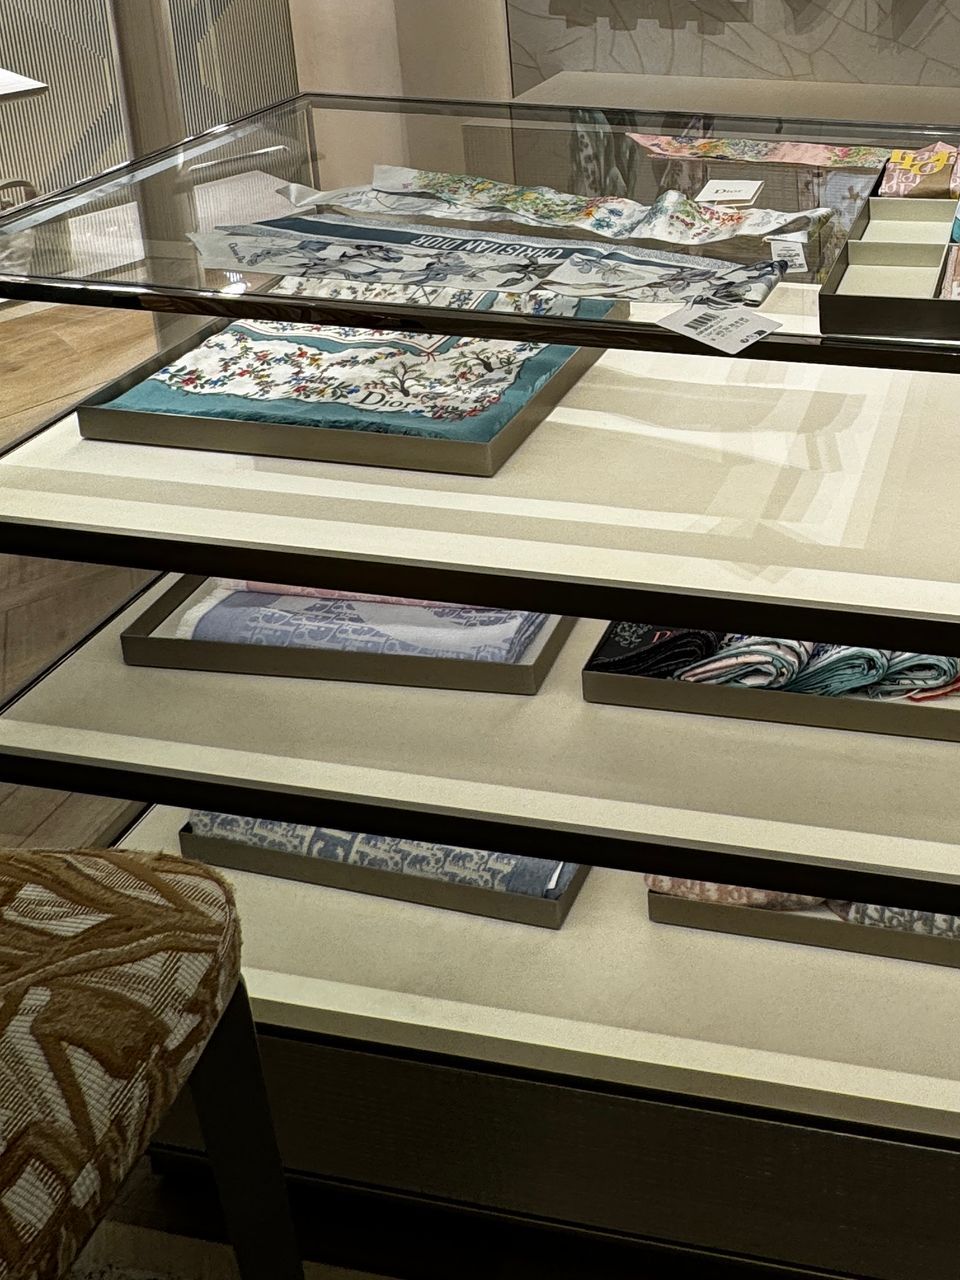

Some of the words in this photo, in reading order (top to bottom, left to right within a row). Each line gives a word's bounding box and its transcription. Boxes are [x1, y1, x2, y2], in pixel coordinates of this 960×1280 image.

[410, 234, 462, 250] DIOR
[461, 239, 564, 260] CHRISTIAN
[355, 391, 416, 408] Dior
